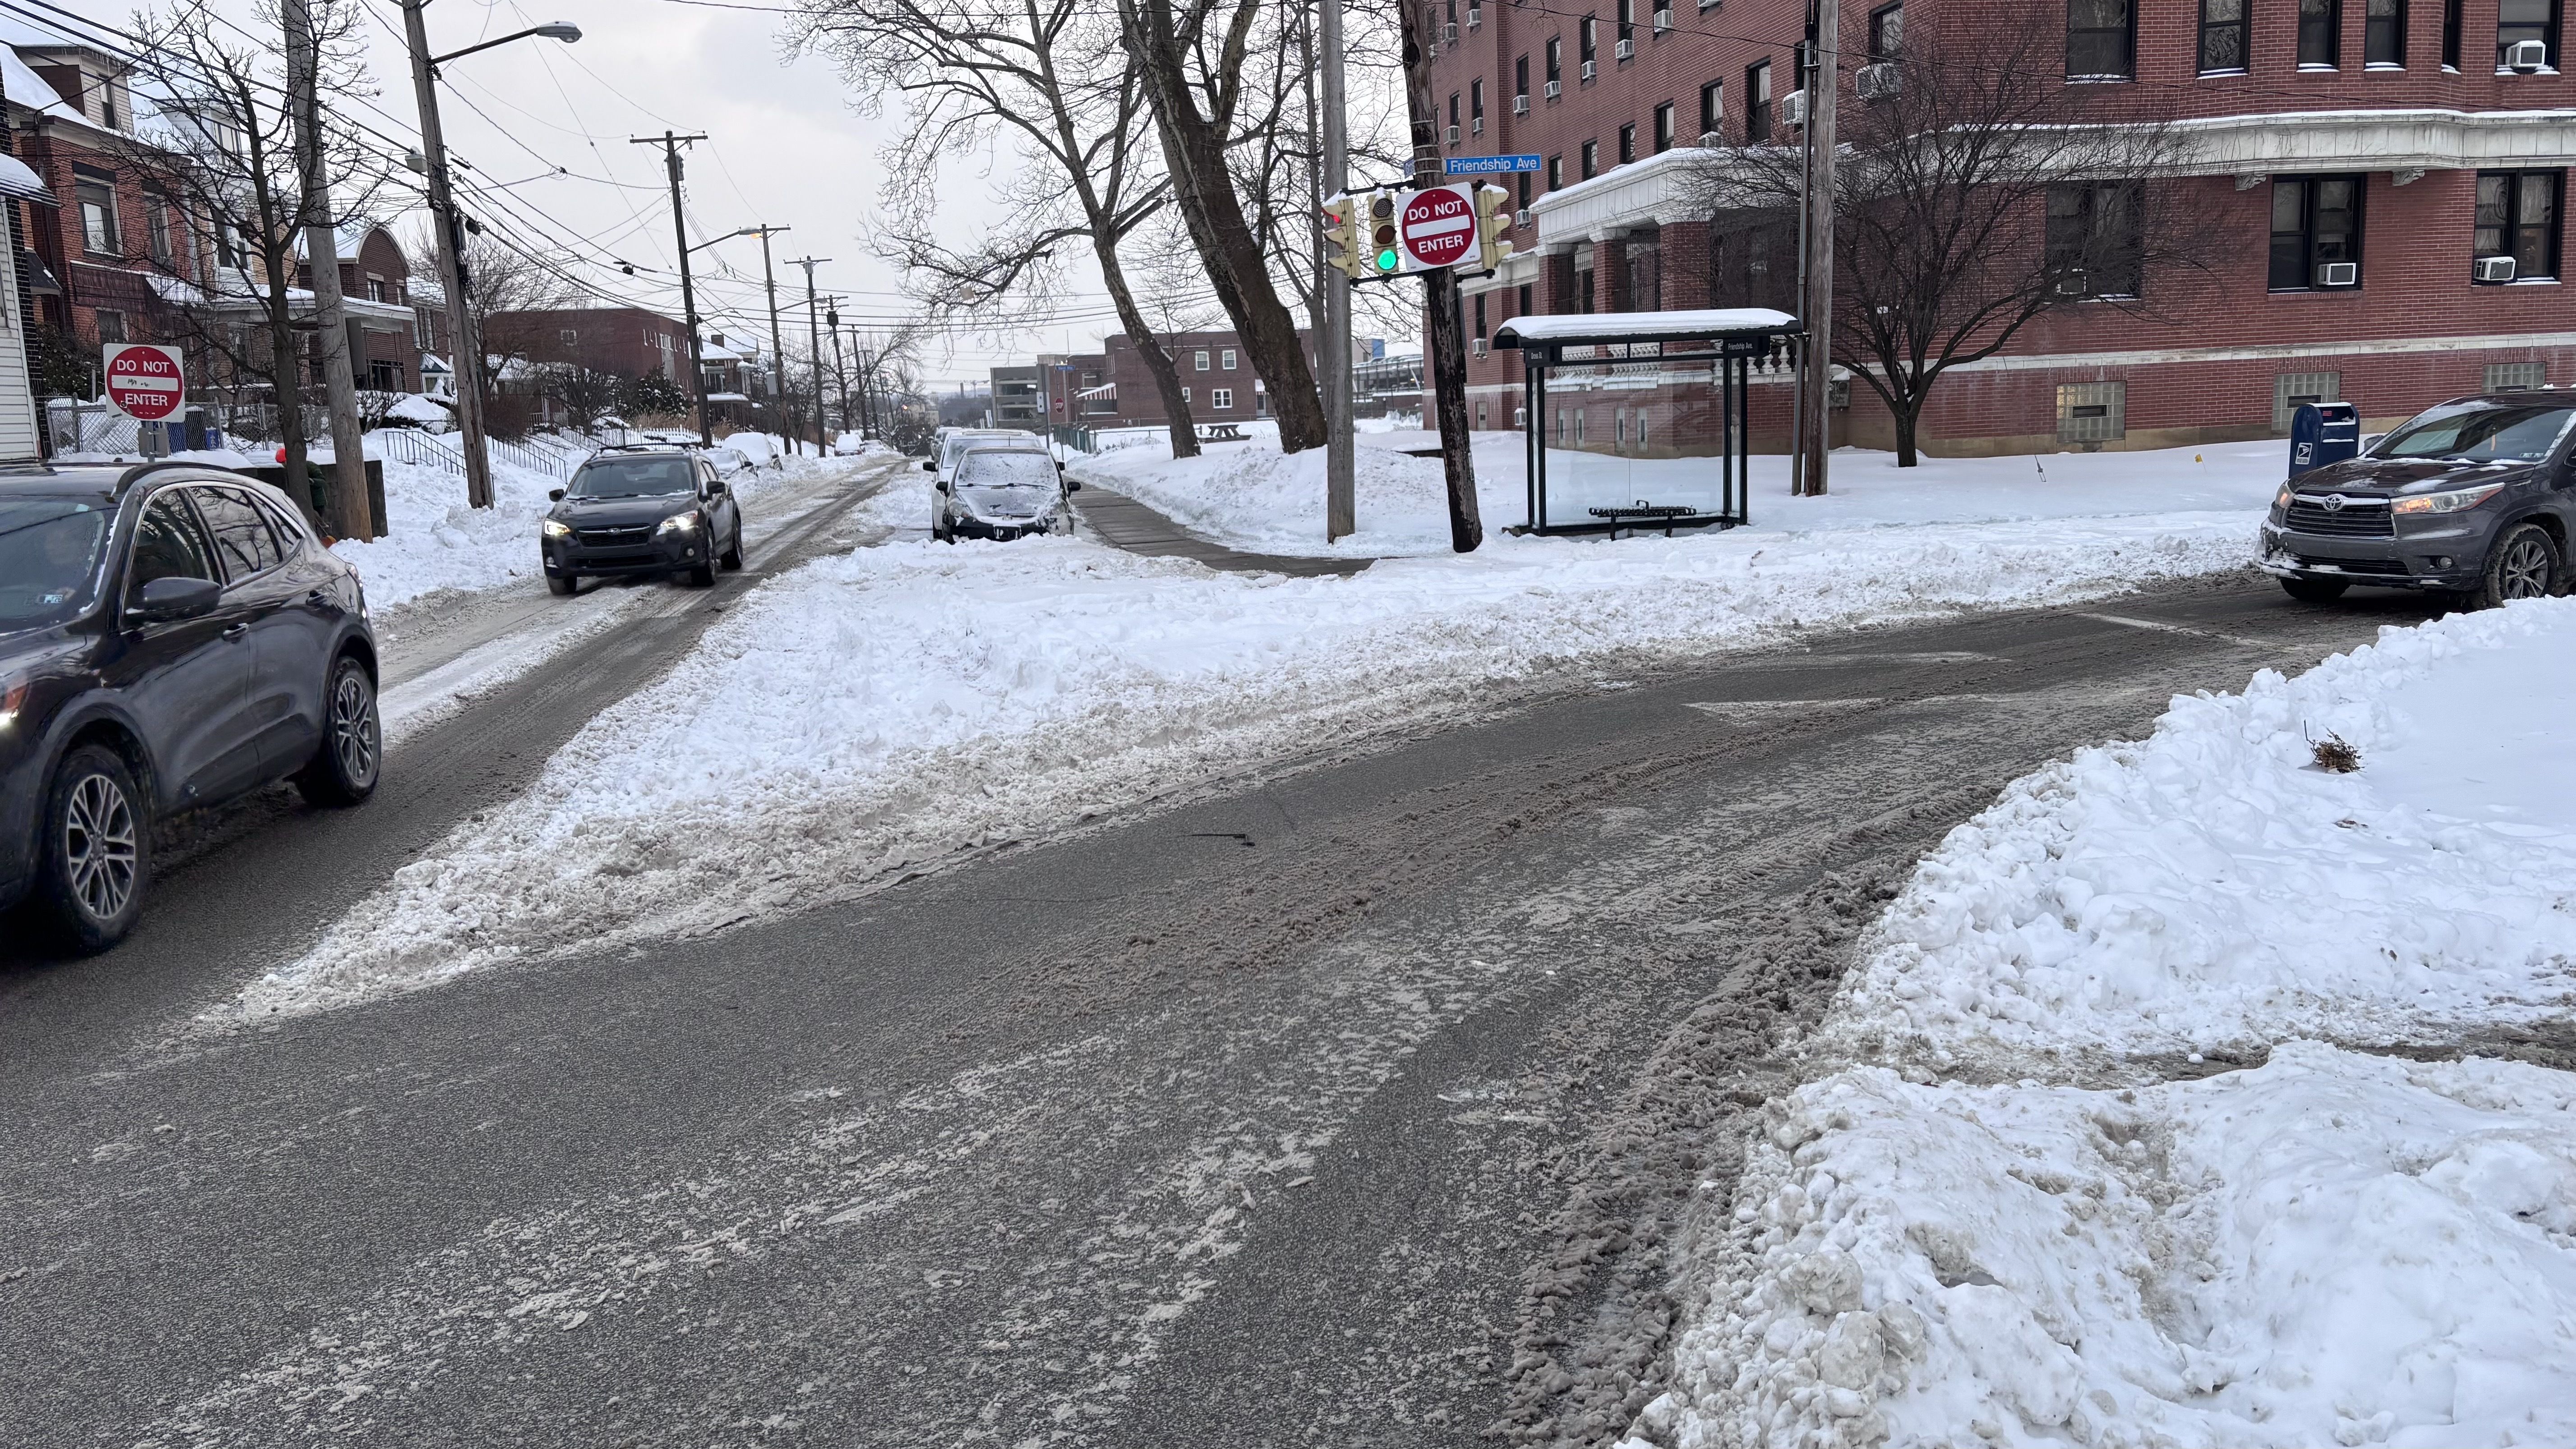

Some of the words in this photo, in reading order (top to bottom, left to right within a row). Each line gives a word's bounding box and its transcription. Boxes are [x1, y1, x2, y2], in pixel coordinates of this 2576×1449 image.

[1450, 158, 1511, 172] Friendship
[1517, 157, 1537, 169] Ave
[1408, 207, 1429, 221] DO
[1435, 200, 1463, 216] NOT
[1418, 235, 1464, 253] ENTER
[117, 359, 137, 372] DO
[143, 361, 170, 373] NOT
[125, 393, 168, 406] ENTER
